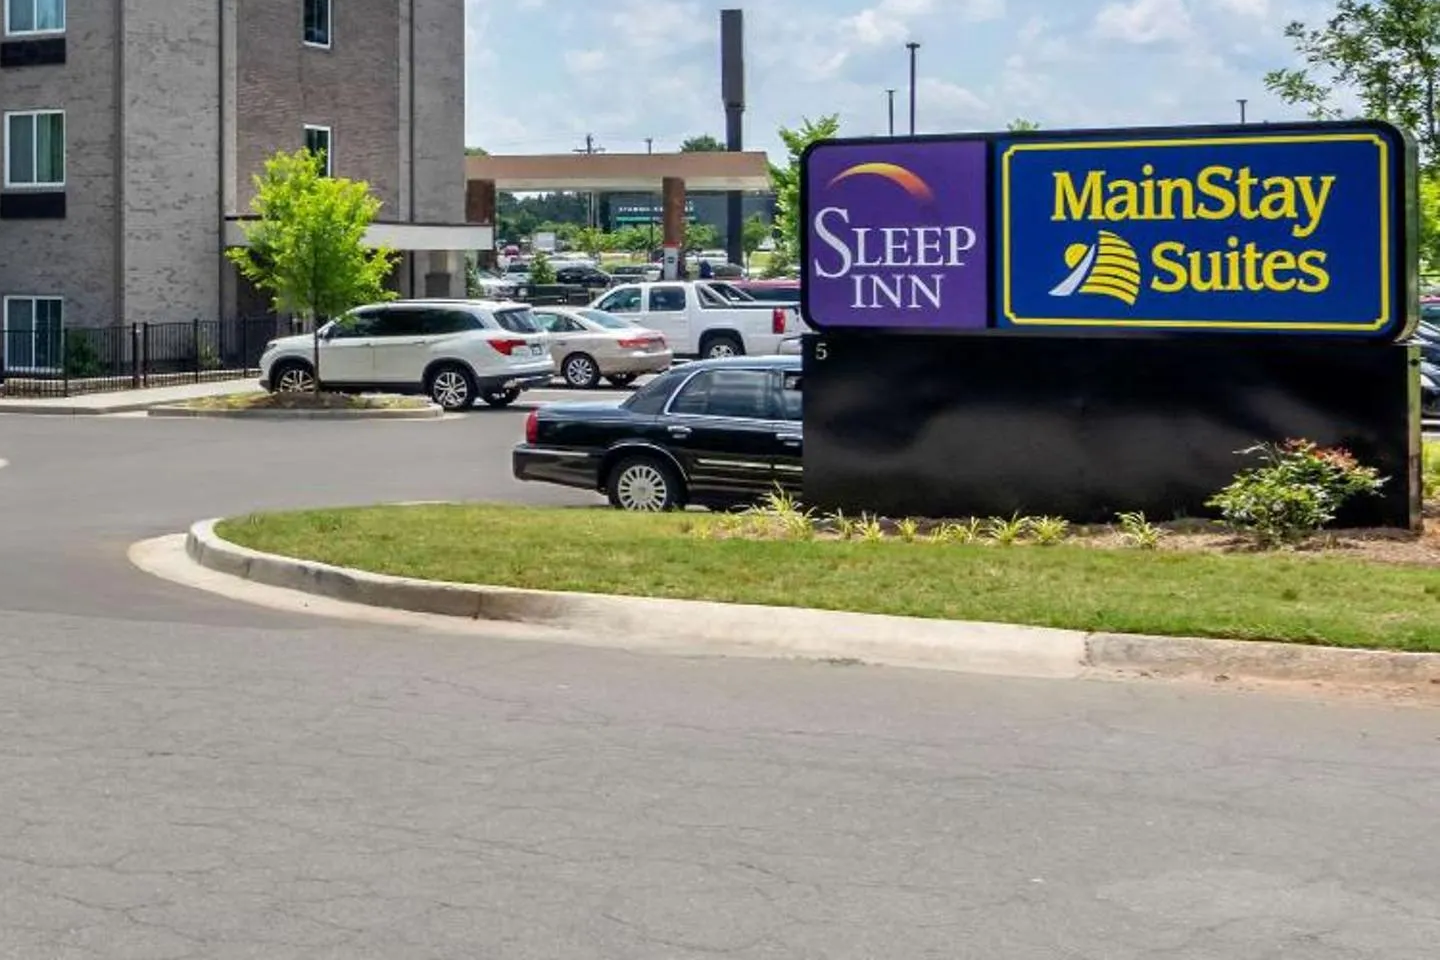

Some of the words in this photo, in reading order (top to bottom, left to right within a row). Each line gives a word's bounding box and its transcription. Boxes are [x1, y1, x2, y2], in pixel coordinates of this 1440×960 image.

[1050, 163, 1336, 237] MainStay
[814, 206, 977, 279] SLEEP
[1150, 236, 1330, 292] Suites
[850, 274, 945, 309] INN
